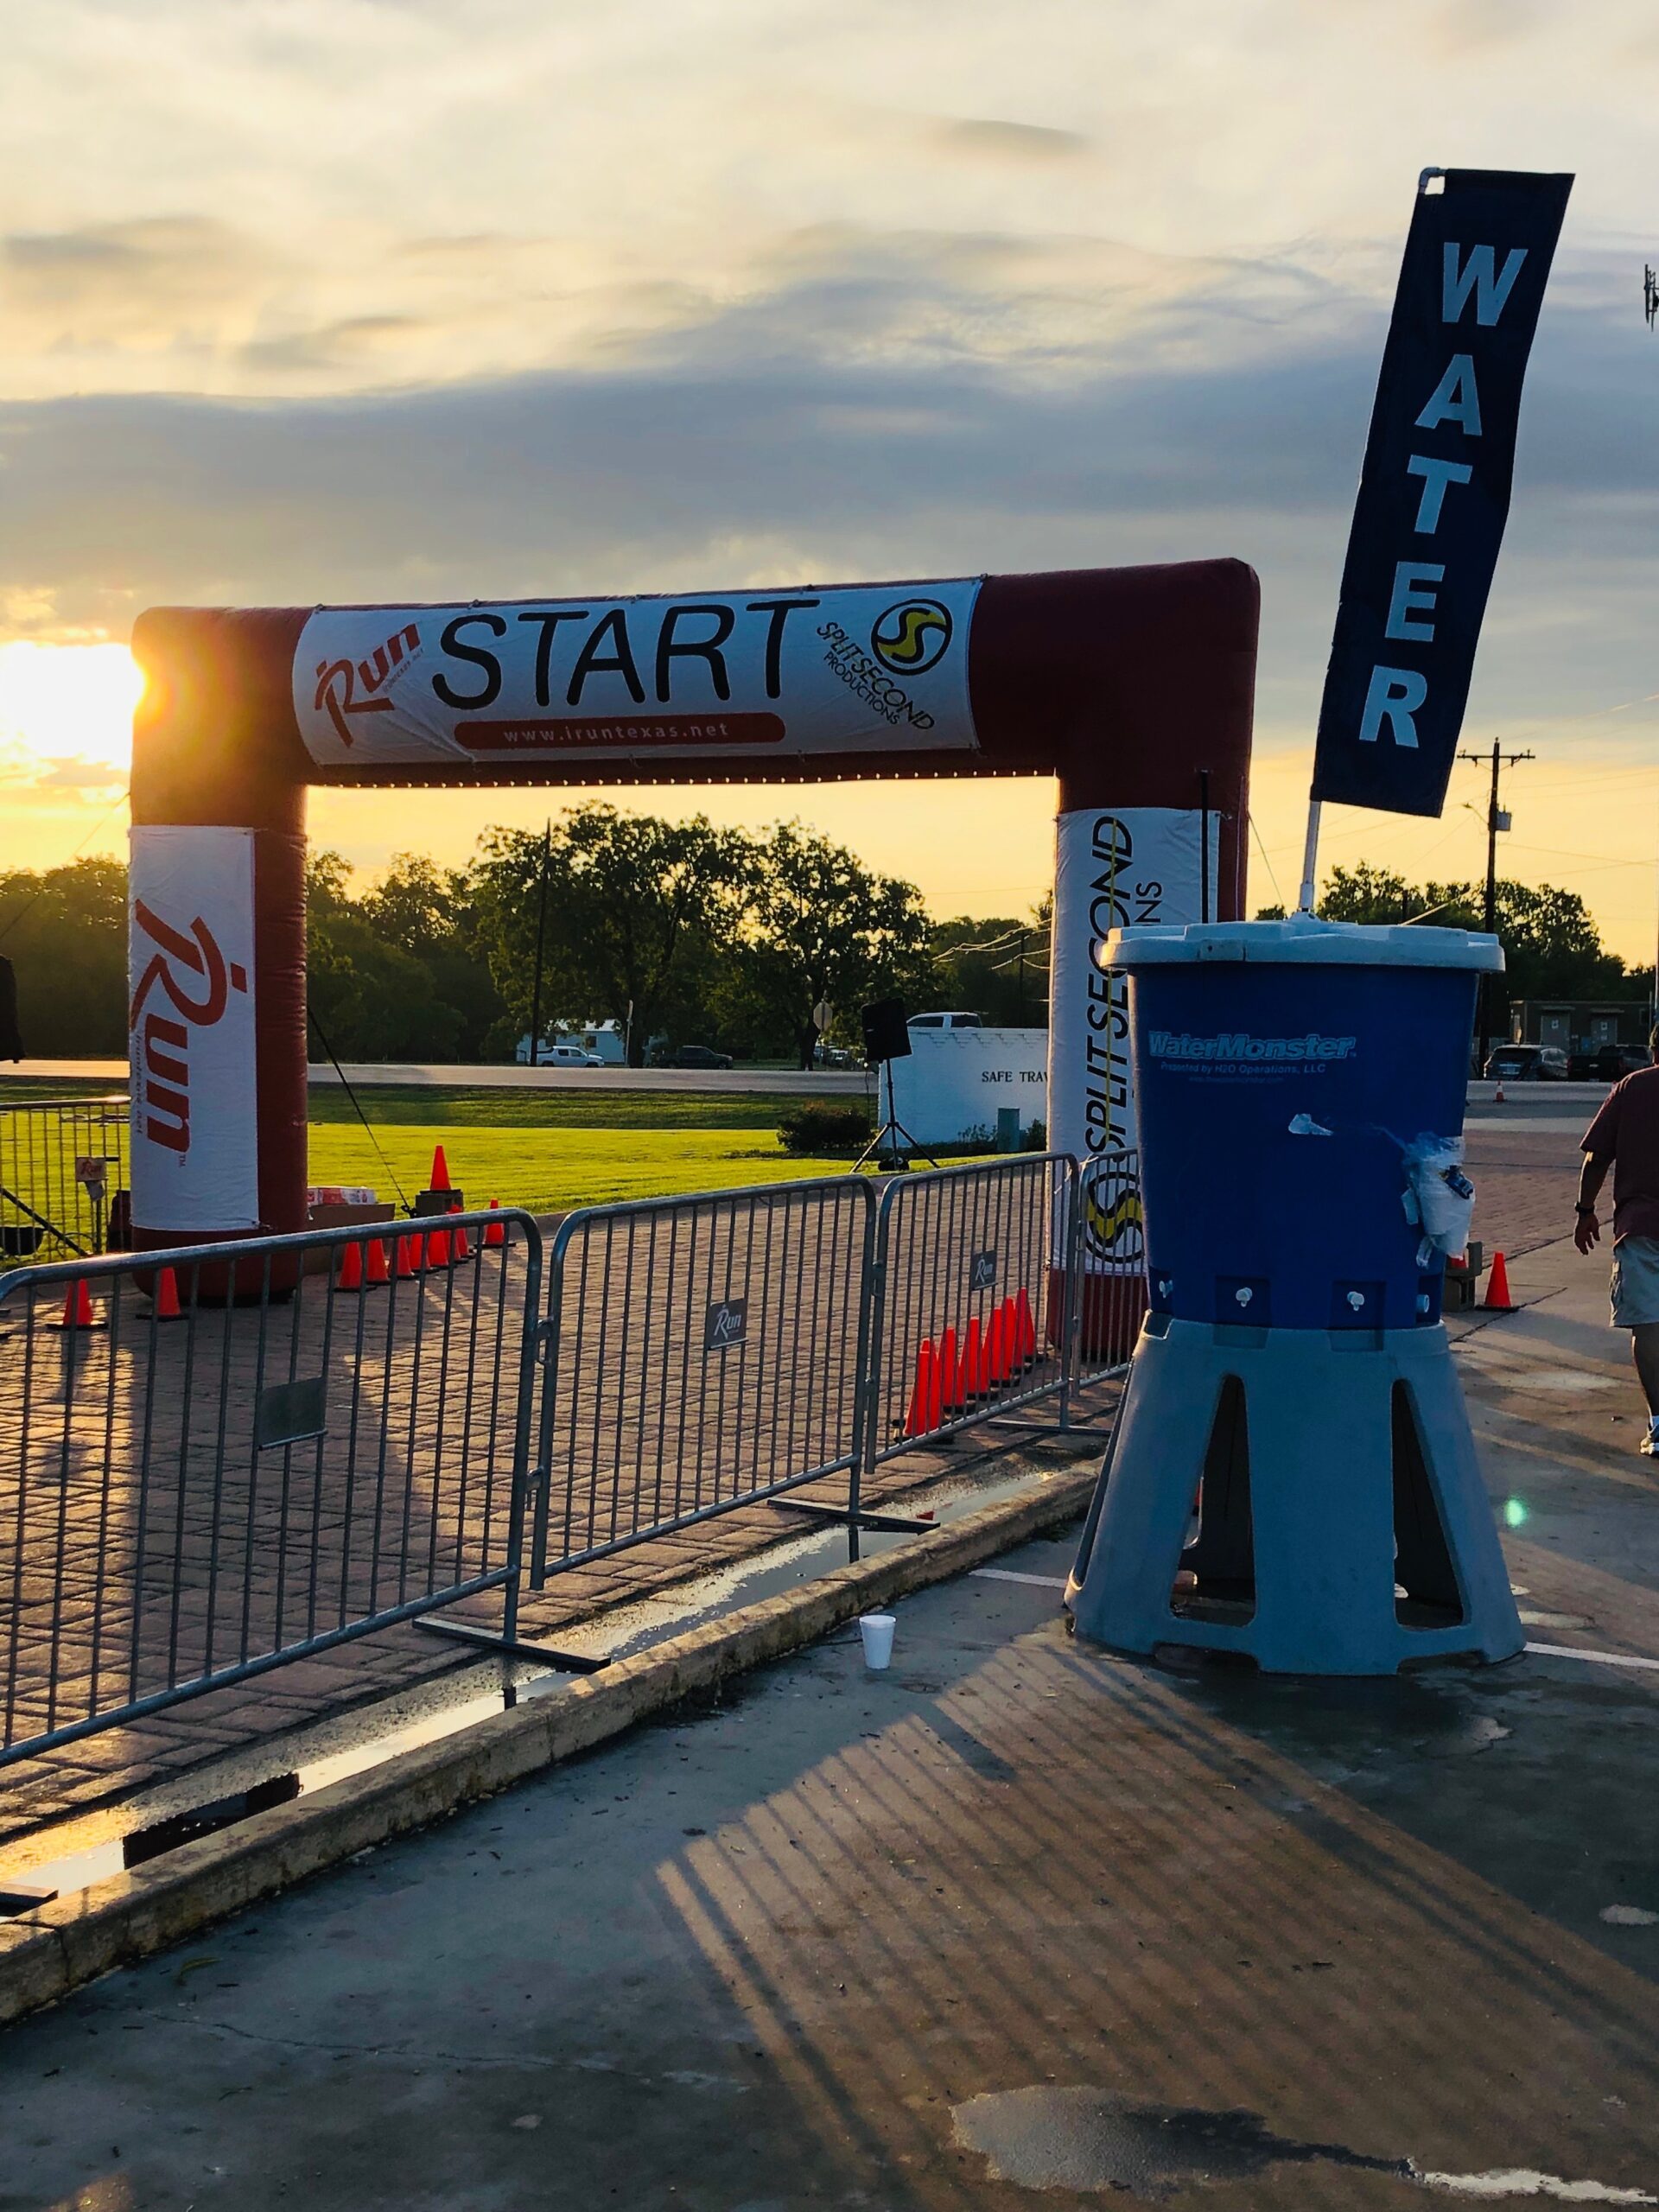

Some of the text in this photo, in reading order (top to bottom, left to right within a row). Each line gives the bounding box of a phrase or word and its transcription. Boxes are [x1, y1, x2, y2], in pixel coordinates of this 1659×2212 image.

[1358, 241, 1529, 748] WATER
[431, 599, 821, 711] START
[817, 621, 936, 730] SPLIT SECOND
[823, 651, 900, 725] PRODUCTIONS
[503, 721, 729, 743] www.iruntexas.net
[1148, 1031, 1356, 1060] WaterMonster
[1303, 1063, 1326, 1074] LLC
[982, 1071, 1014, 1083] SAFE
